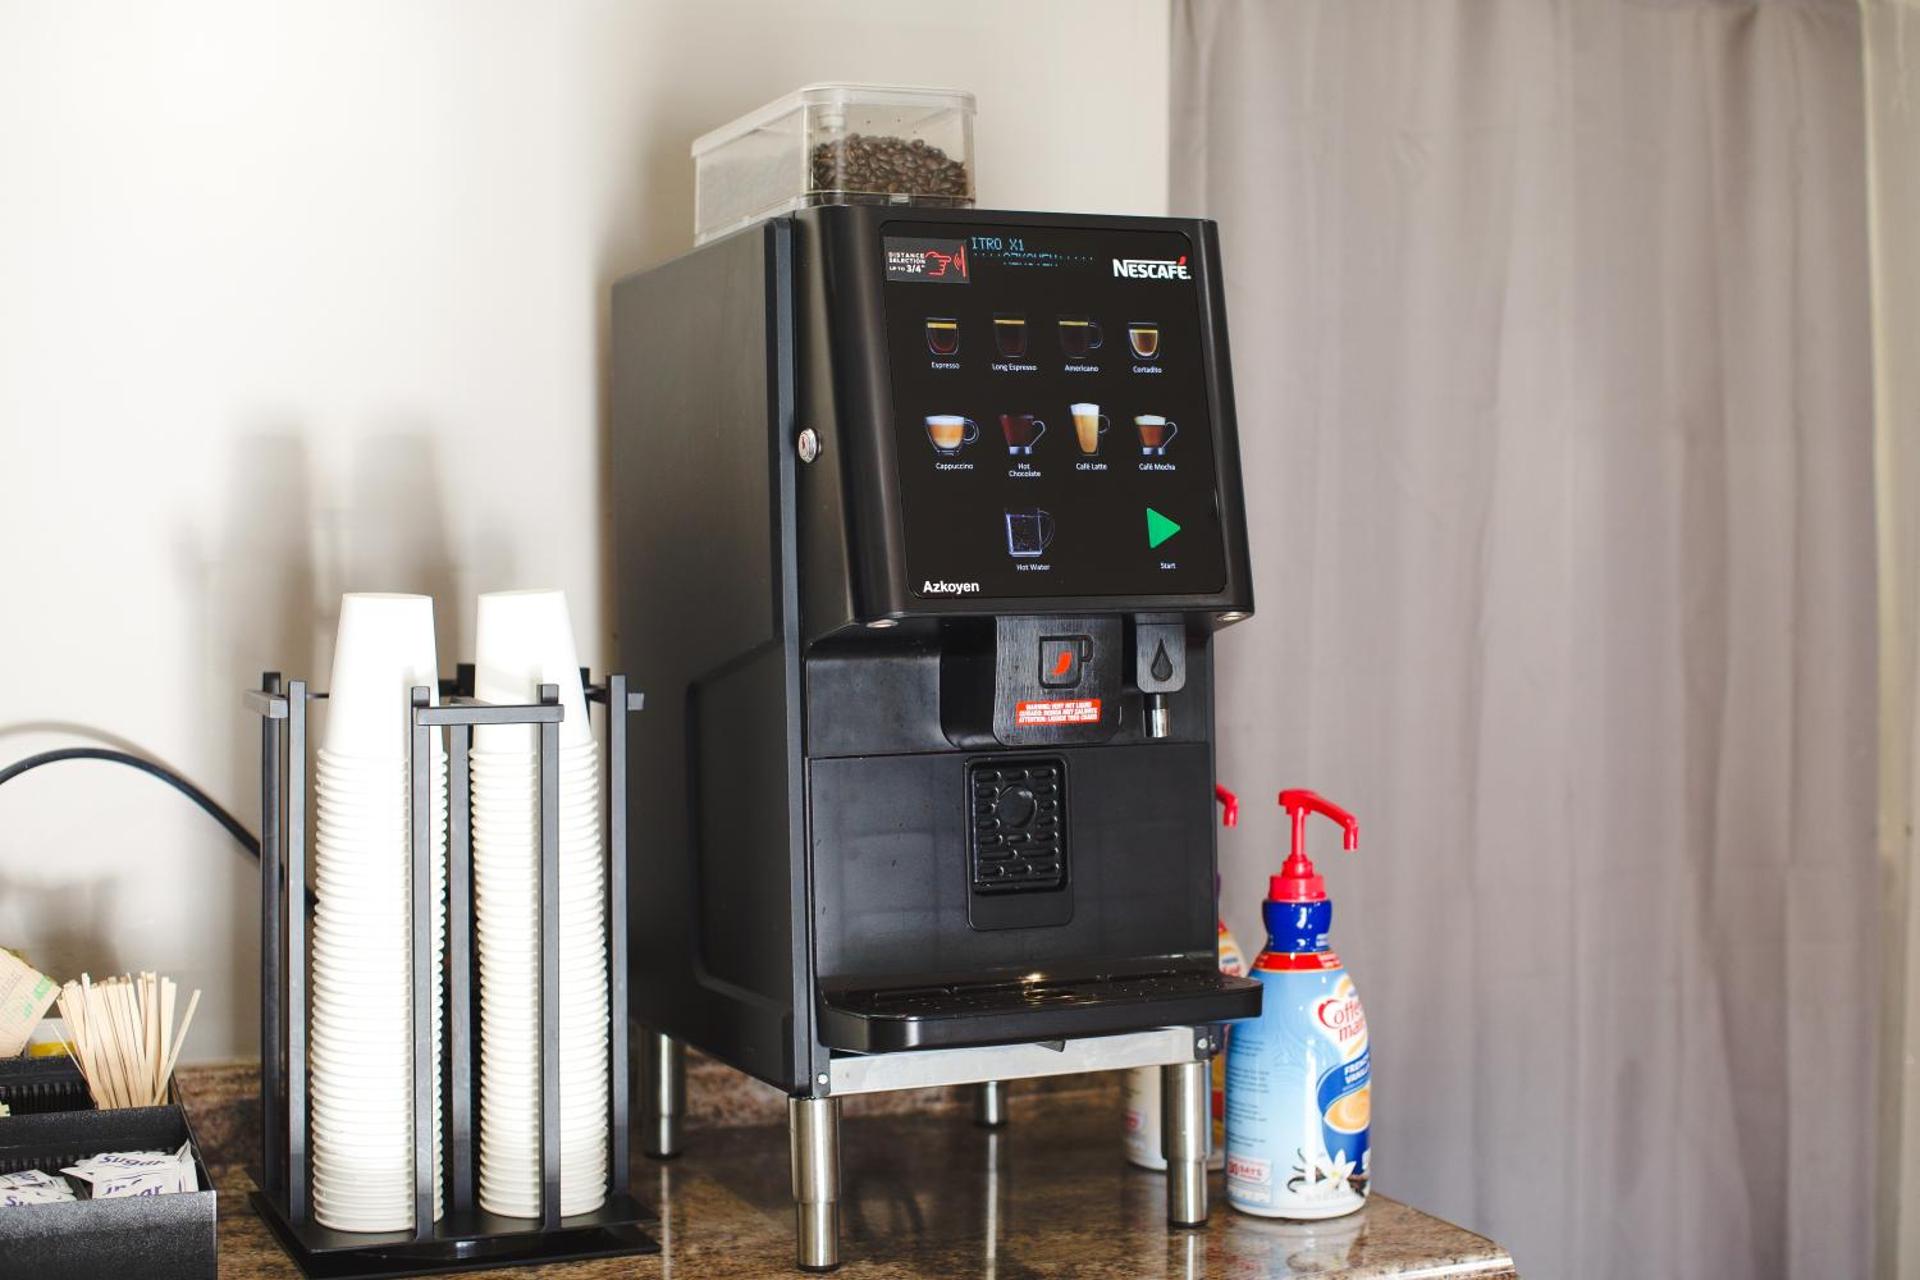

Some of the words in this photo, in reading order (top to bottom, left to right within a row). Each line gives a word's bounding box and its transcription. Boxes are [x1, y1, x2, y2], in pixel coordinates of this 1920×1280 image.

[931, 361, 960, 370] Espresso
[991, 363, 1008, 372] Long
[1009, 363, 1038, 372] Espresso
[1064, 364, 1099, 373] Americano
[935, 462, 974, 472] Cappuccino
[1091, 462, 1108, 471] Latte
[1154, 463, 1176, 471] Mocha
[1016, 563, 1029, 571] Hot
[1030, 563, 1050, 571] Water
[923, 580, 980, 595] Azkoyen
[98, 1154, 166, 1168] Sugar
